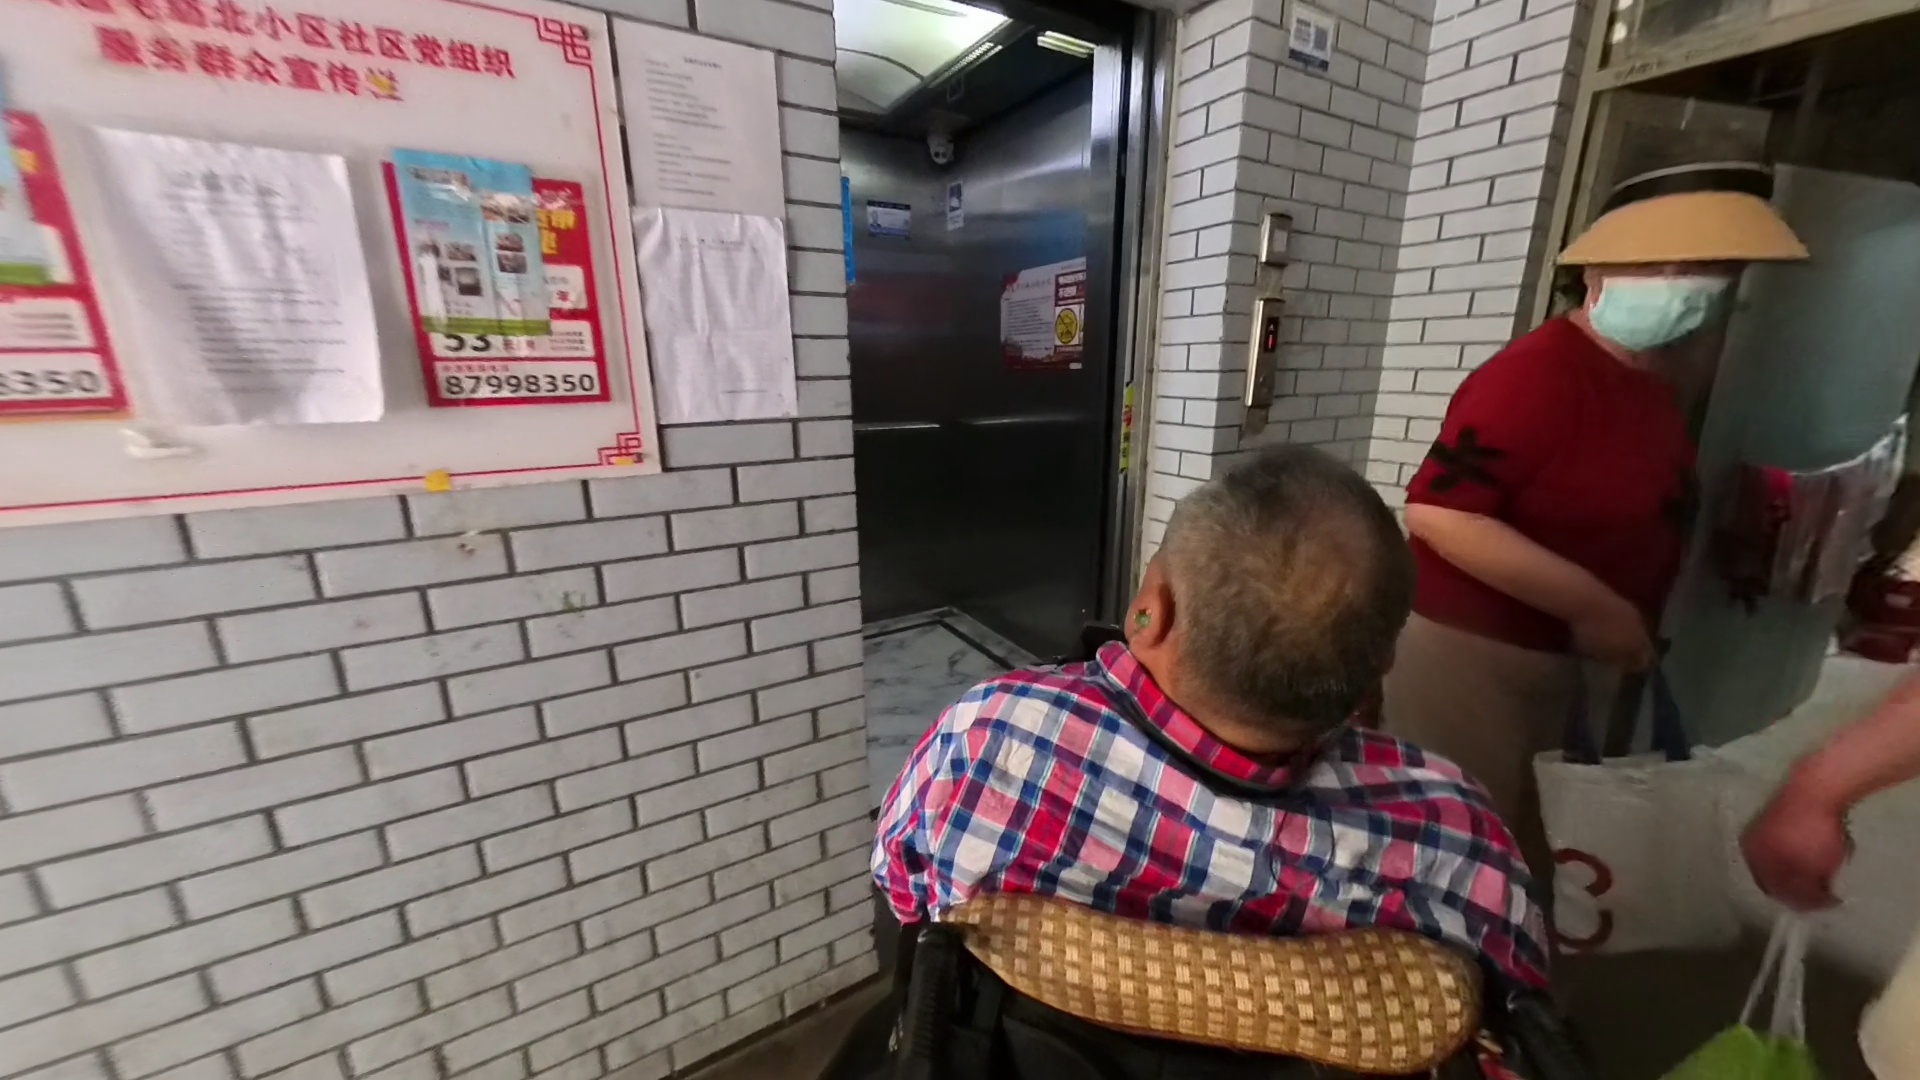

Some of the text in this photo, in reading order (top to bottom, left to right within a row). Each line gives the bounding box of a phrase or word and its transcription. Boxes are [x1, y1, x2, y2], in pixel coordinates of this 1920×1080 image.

[45, 0, 515, 79] 北小区社区党组织
[445, 374, 595, 395] 87998350
